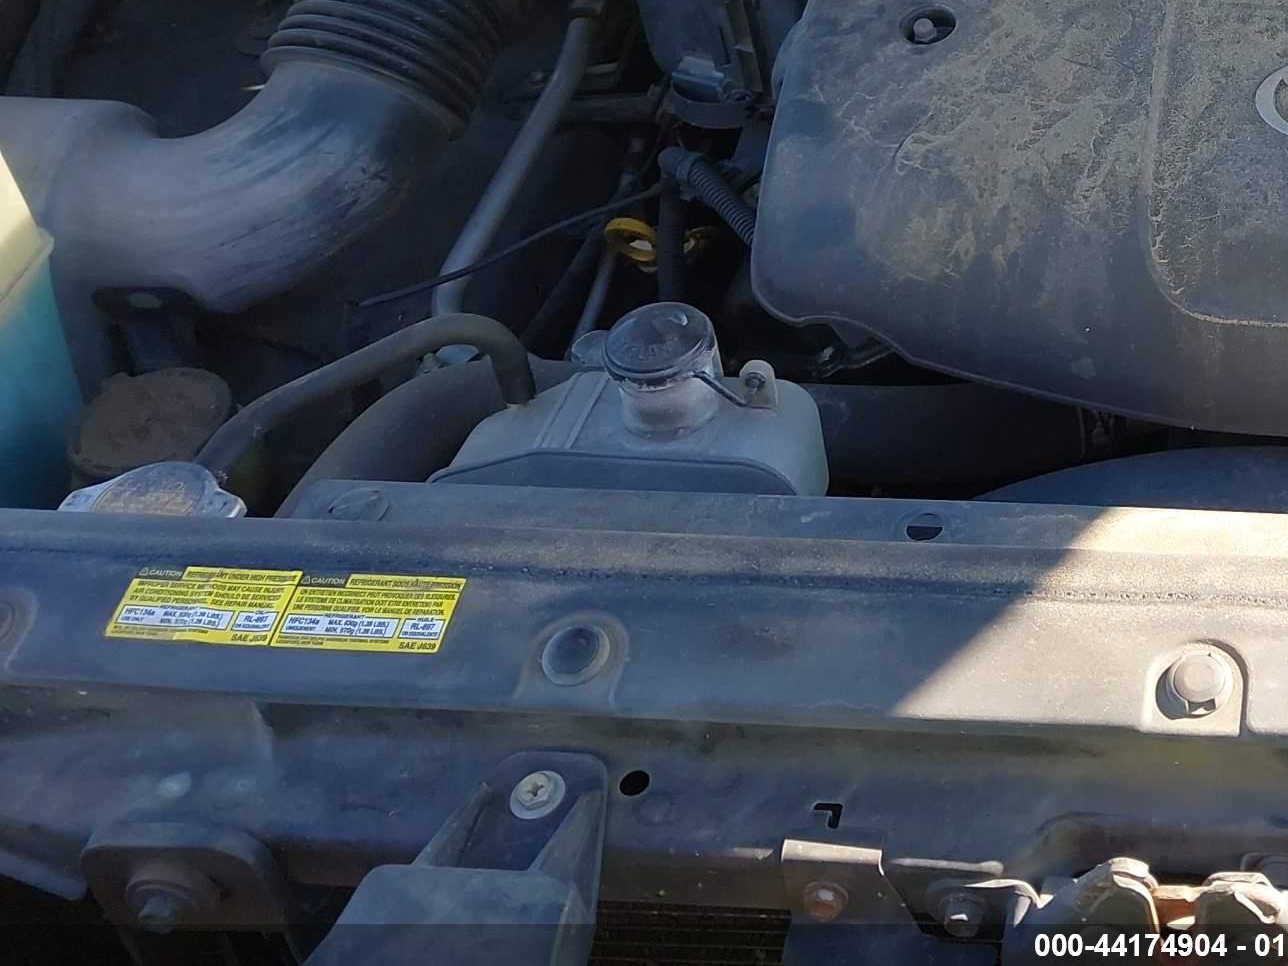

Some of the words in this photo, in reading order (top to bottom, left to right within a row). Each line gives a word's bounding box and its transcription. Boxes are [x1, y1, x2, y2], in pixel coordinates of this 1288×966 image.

[149, 569, 182, 577] CAUTION
[228, 572, 249, 580] UNDER
[311, 577, 345, 585] CAUTION
[145, 588, 189, 596] CONDITIONING
[124, 607, 156, 616] HFC134a
[288, 616, 320, 625] HFC134a
[231, 633, 249, 642] SAE
[249, 634, 268, 642] J639
[417, 642, 437, 650] J639
